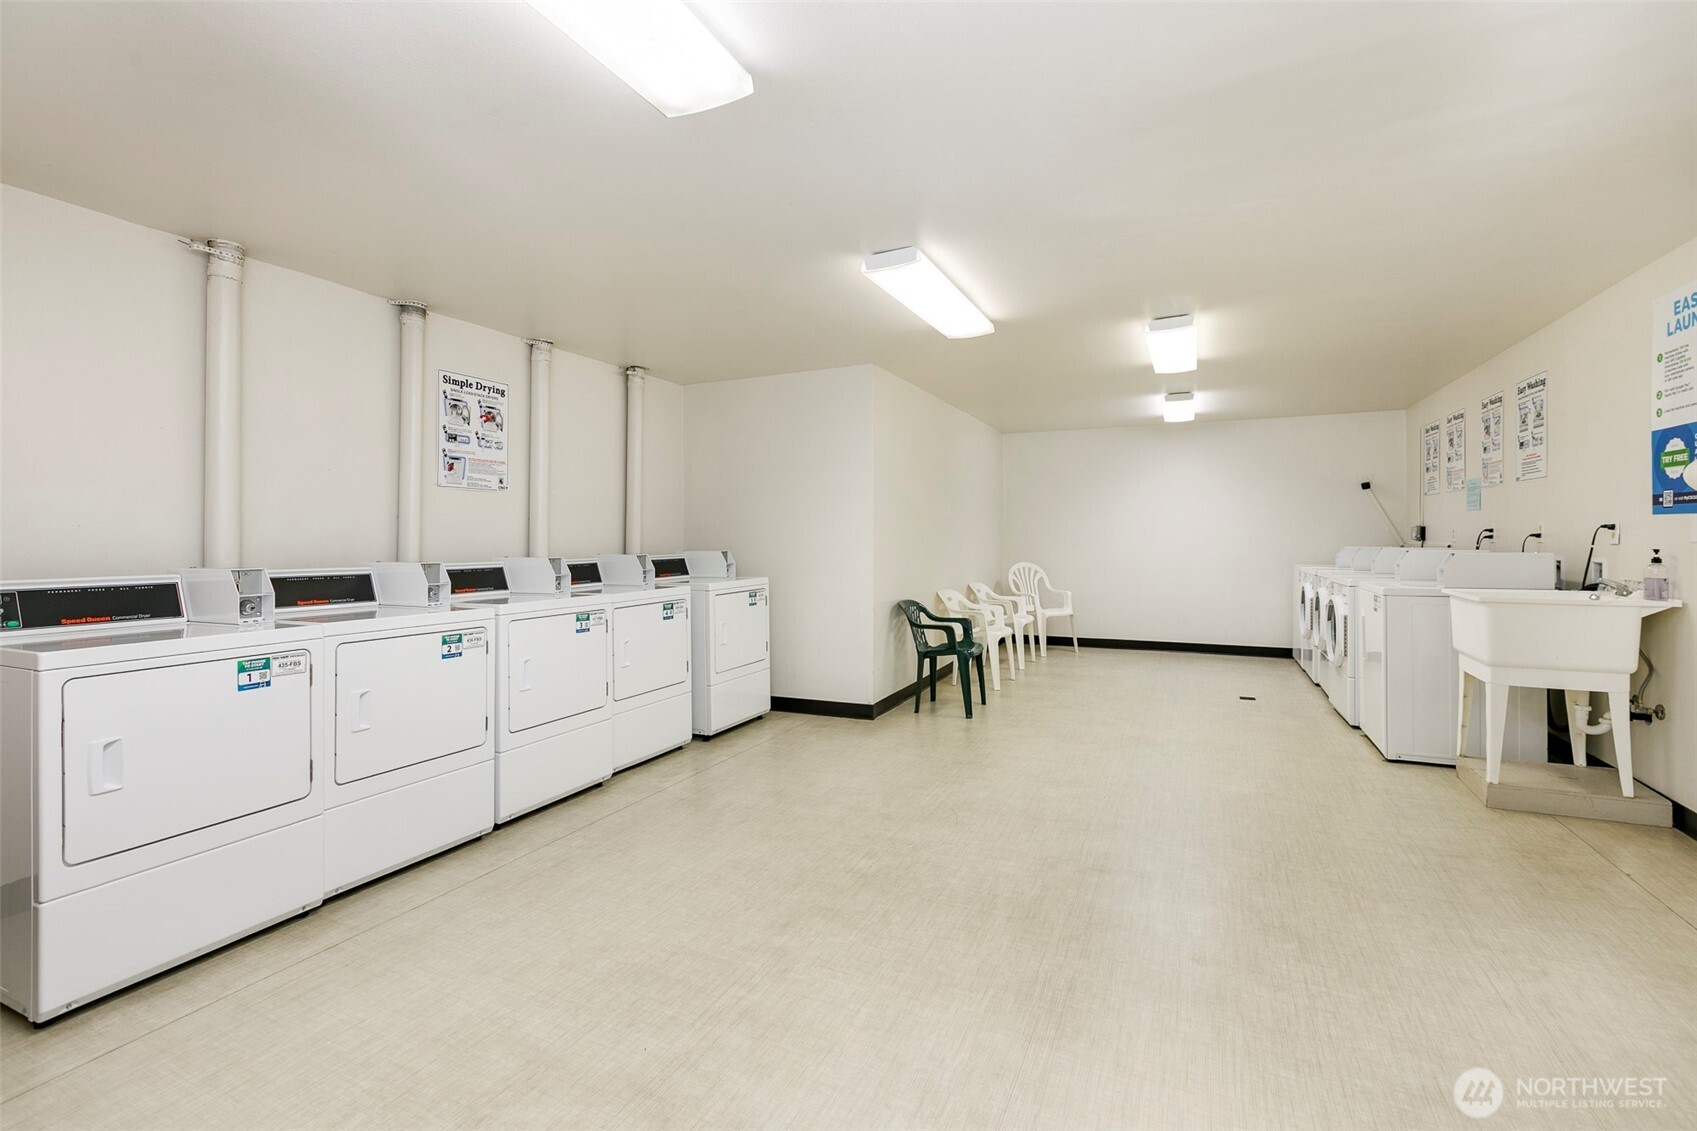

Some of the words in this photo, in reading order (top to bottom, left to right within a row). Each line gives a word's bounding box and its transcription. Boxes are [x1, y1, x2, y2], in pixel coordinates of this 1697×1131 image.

[1674, 292, 1697, 316] EAS
[1667, 312, 1697, 337] LAUN
[443, 375, 474, 390] Simple
[475, 382, 506, 398] Drying
[1527, 378, 1546, 390] Washing
[1662, 455, 1673, 464] TRY
[1673, 453, 1688, 462] FREE
[61, 617, 86, 625] Speed
[278, 661, 302, 669] 435-FBS
[247, 673, 251, 682] 1
